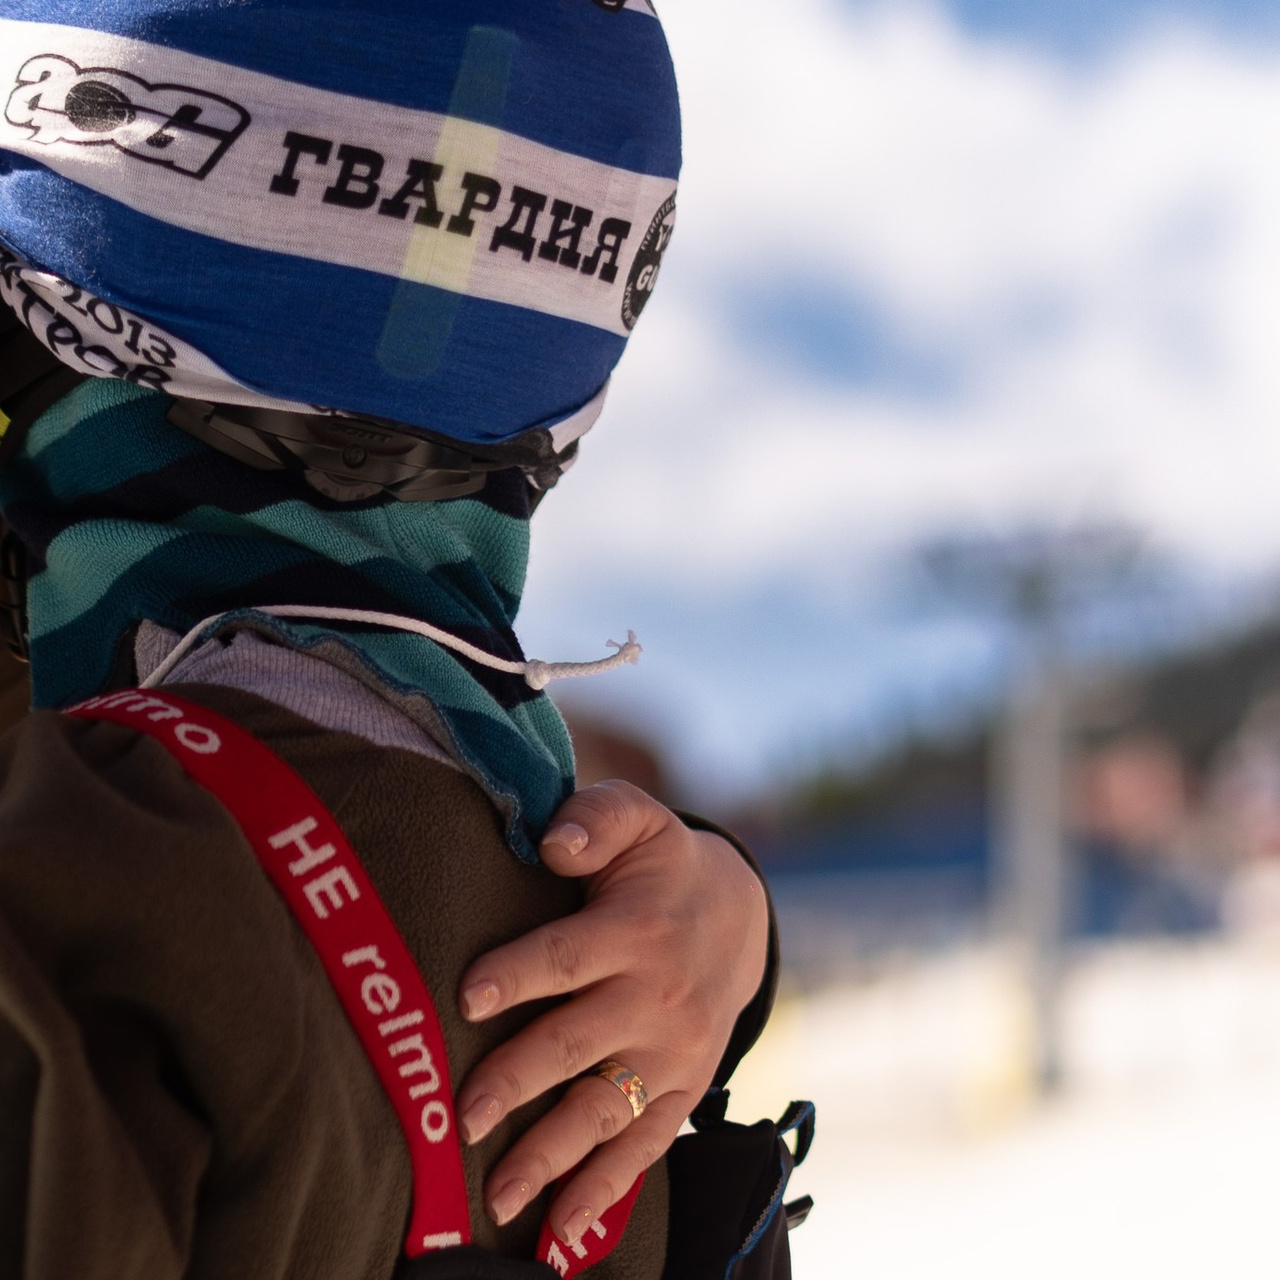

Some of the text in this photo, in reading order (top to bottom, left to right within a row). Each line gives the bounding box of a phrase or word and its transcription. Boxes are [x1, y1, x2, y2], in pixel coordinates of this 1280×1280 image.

[269, 130, 632, 284] ГВАРДИЯ
[55, 280, 177, 369] 2013
[268, 816, 361, 919] HE
